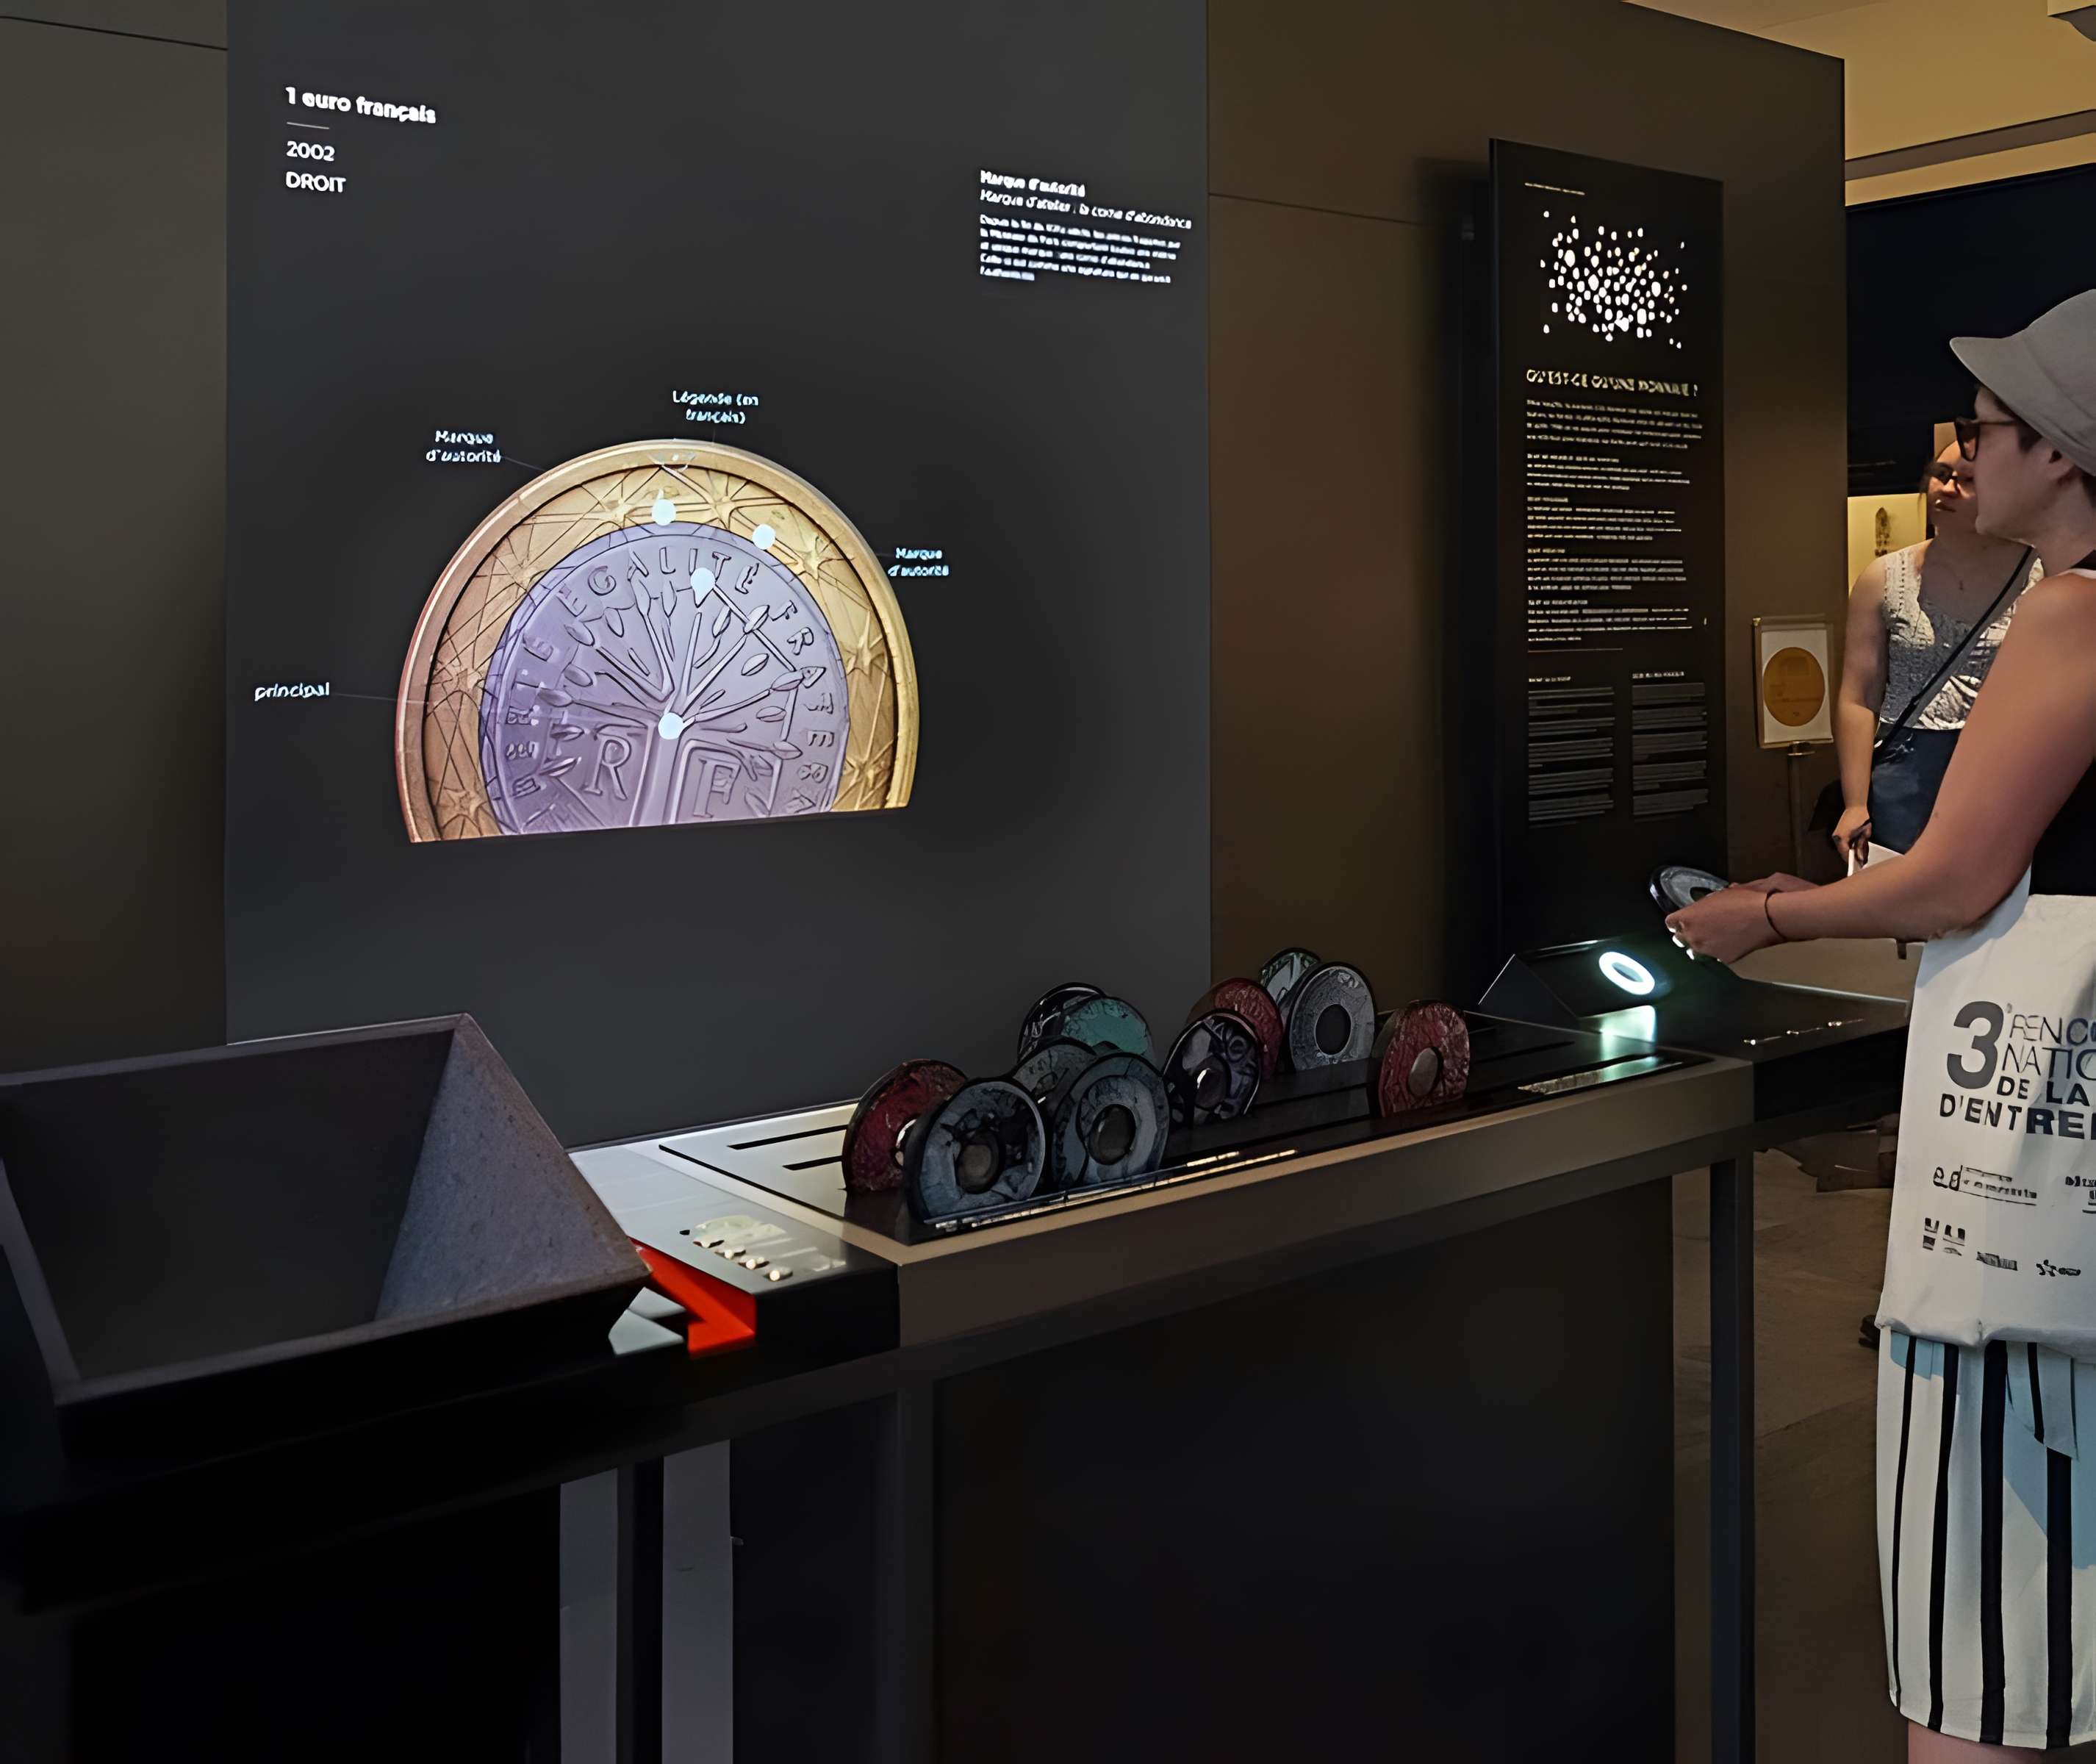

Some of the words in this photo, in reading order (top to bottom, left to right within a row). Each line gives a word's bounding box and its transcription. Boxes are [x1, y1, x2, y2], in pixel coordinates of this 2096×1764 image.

[285, 86, 296, 104] 1
[301, 92, 351, 112] euro
[356, 96, 437, 123] français
[286, 140, 335, 162] 2002
[285, 171, 346, 193] DROIT
[895, 547, 943, 561] Marque
[254, 681, 330, 702] principal
[1996, 1075, 2030, 1100] DE
[2046, 1080, 2090, 1107] LA
